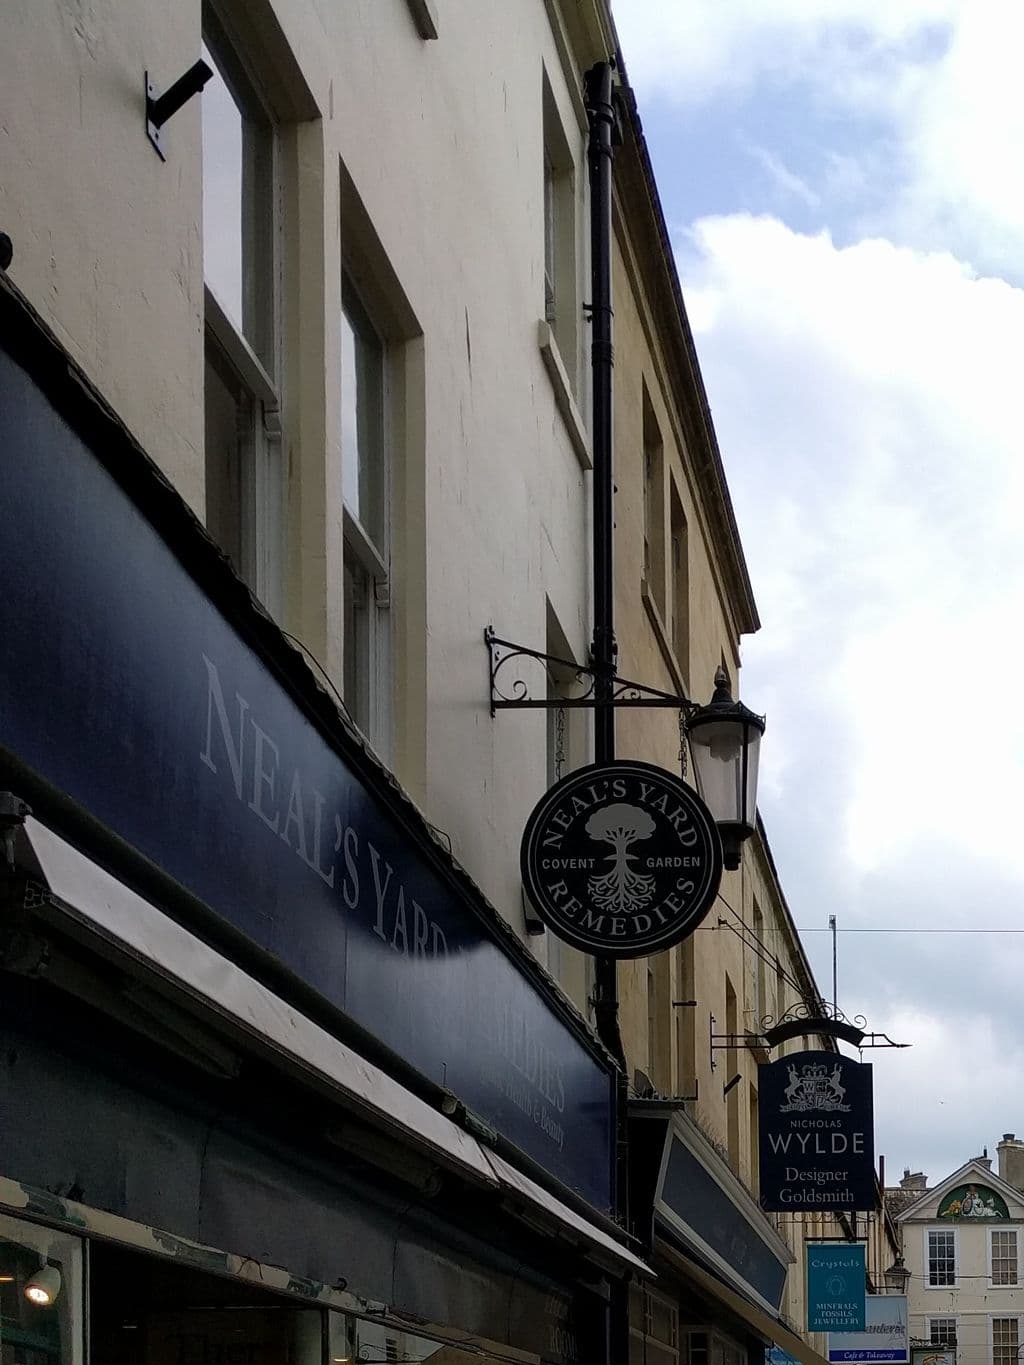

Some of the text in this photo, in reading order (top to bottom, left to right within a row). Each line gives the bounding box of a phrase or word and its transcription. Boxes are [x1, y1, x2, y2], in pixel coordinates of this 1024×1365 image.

[200, 651, 361, 910] NEAL'S
[542, 778, 699, 850] NEAL'S YARD
[541, 856, 702, 871] COVENT GARDEN
[546, 876, 696, 937] REMEDIES
[790, 1119, 843, 1129] NICHOLAS
[767, 1132, 865, 1154] WYLDE
[785, 1167, 849, 1185] Designer
[779, 1188, 855, 1203] Goldsmith
[810, 1258, 861, 1271] Crystals
[816, 1302, 858, 1310] MINERALS
[813, 1317, 859, 1326] JEWELLERY
